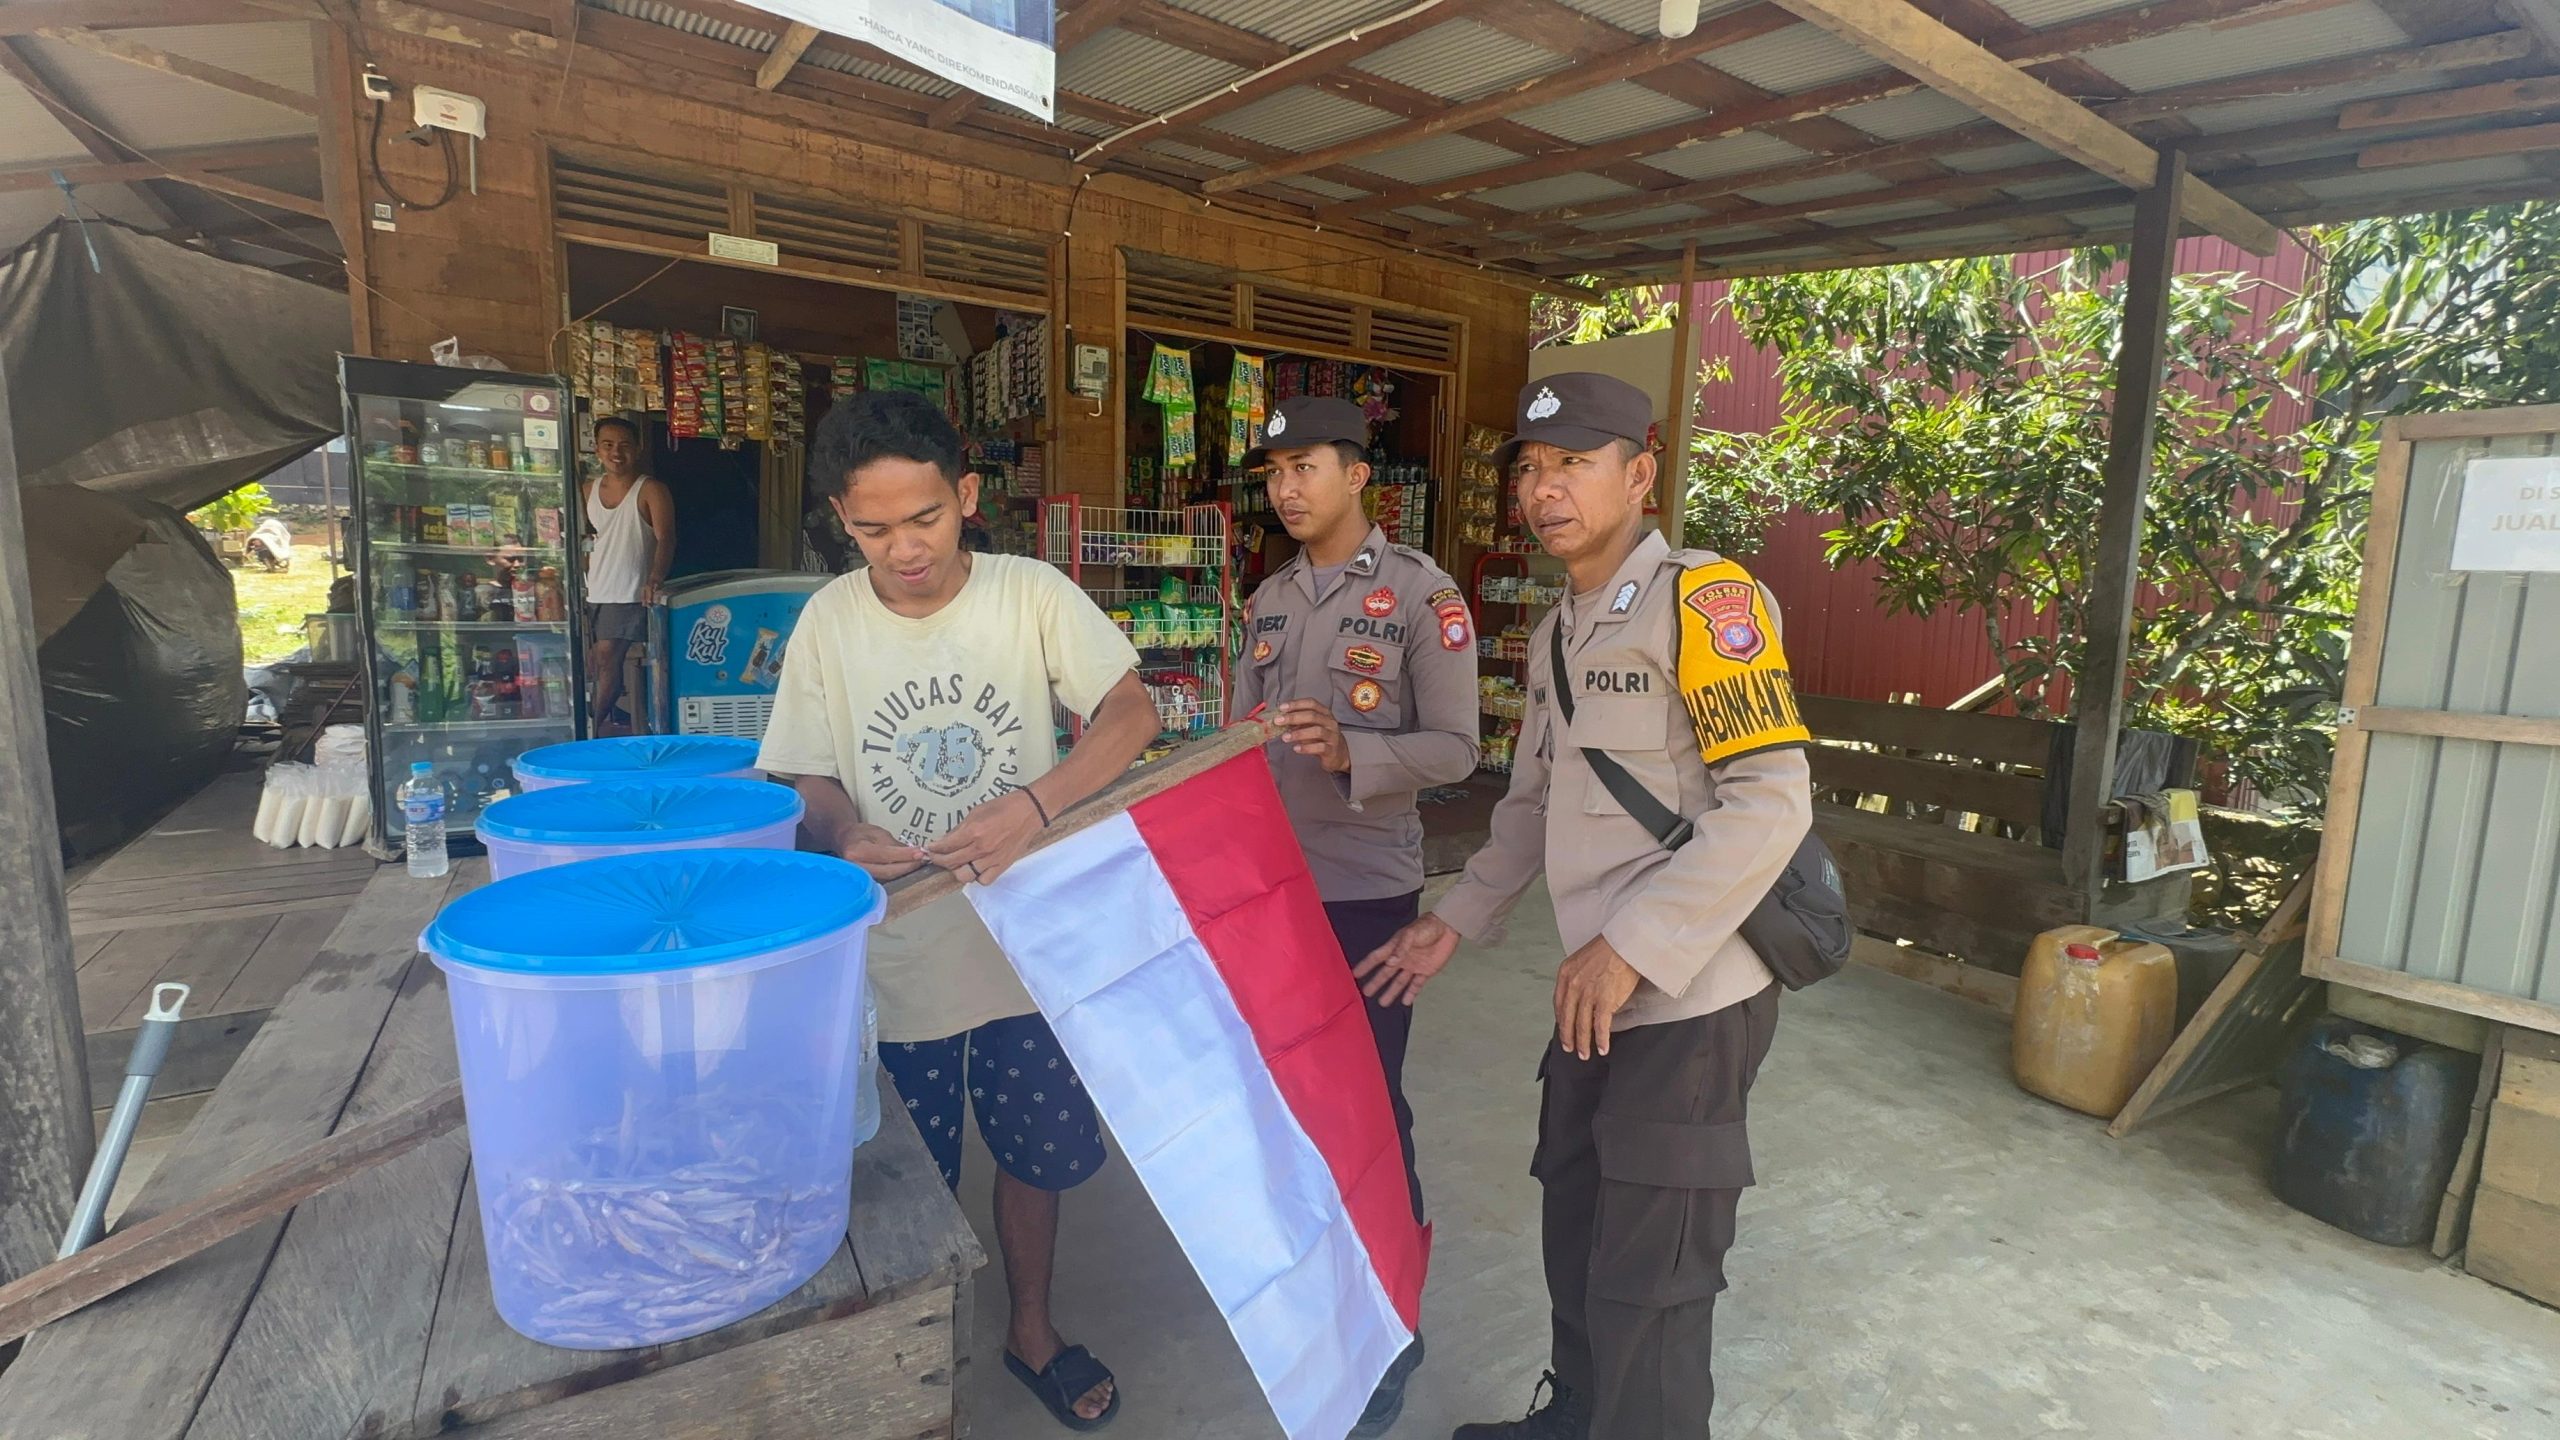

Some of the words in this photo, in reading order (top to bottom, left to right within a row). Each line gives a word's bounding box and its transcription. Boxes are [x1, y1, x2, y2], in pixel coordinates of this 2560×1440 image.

[904, 38, 935, 59] YANG
[2520, 486, 2544, 501] DI
[2491, 513, 2560, 532] JUAL
[1338, 617, 1406, 643] POLRI
[1585, 670, 1650, 694] POLRI
[862, 673, 964, 754] TIJUCAS
[973, 682, 1023, 738] BAY
[871, 775, 908, 815] RIO
[909, 806, 937, 834] DE
